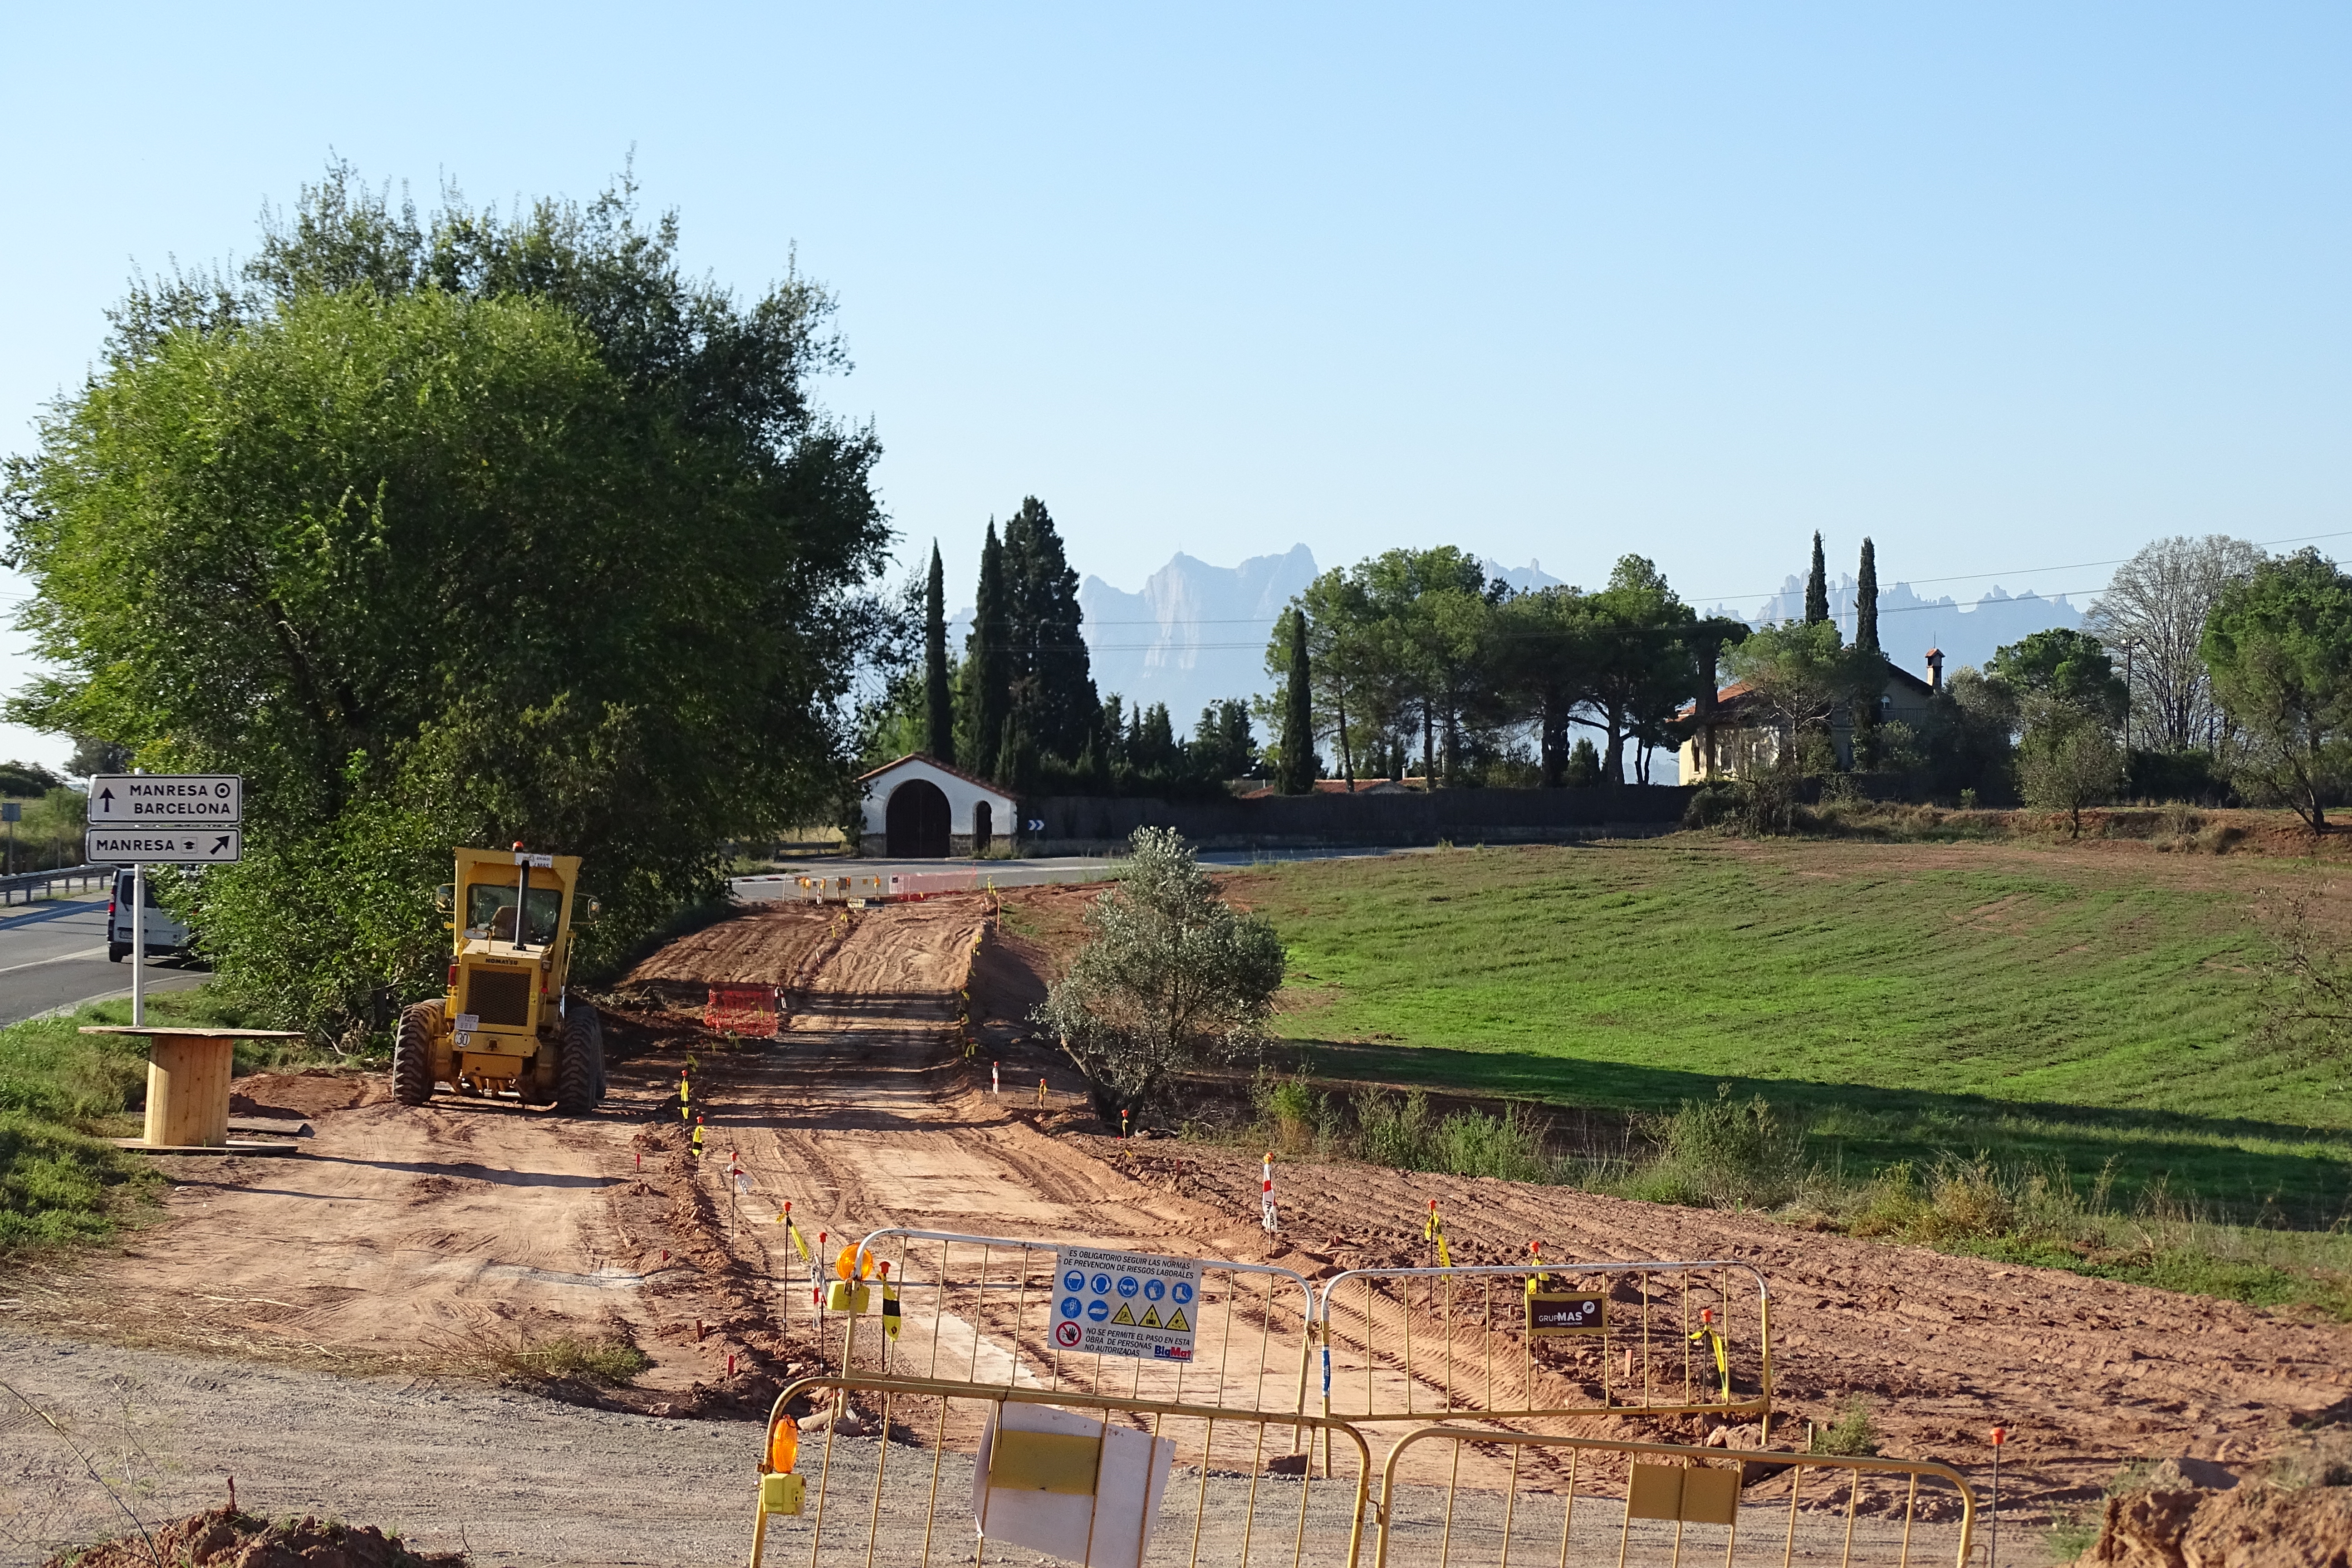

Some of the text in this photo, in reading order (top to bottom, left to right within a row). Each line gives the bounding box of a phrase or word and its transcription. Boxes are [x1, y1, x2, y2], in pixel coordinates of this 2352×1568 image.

[130, 784, 208, 796] MANRESA
[134, 803, 230, 814] BARCELONA
[96, 839, 175, 851] MANRESA
[457, 1033, 468, 1045] 30
[1079, 1251, 1122, 1262] OBLIGATORIO
[1123, 1256, 1147, 1264] SEGUIR
[1162, 1260, 1191, 1269] NORMAS
[1073, 1259, 1116, 1270] PREVENCION
[1127, 1265, 1155, 1274] RIESGOS
[1156, 1269, 1194, 1279] LABORALES
[1107, 1330, 1136, 1339] PERMITE
[1145, 1334, 1163, 1343] PASO
[1175, 1338, 1190, 1346] ESTA
[1117, 1339, 1152, 1350] PERSONAS
[1095, 1345, 1140, 1357] AUTORIZADAS
[1154, 1345, 1191, 1358] BigMat
